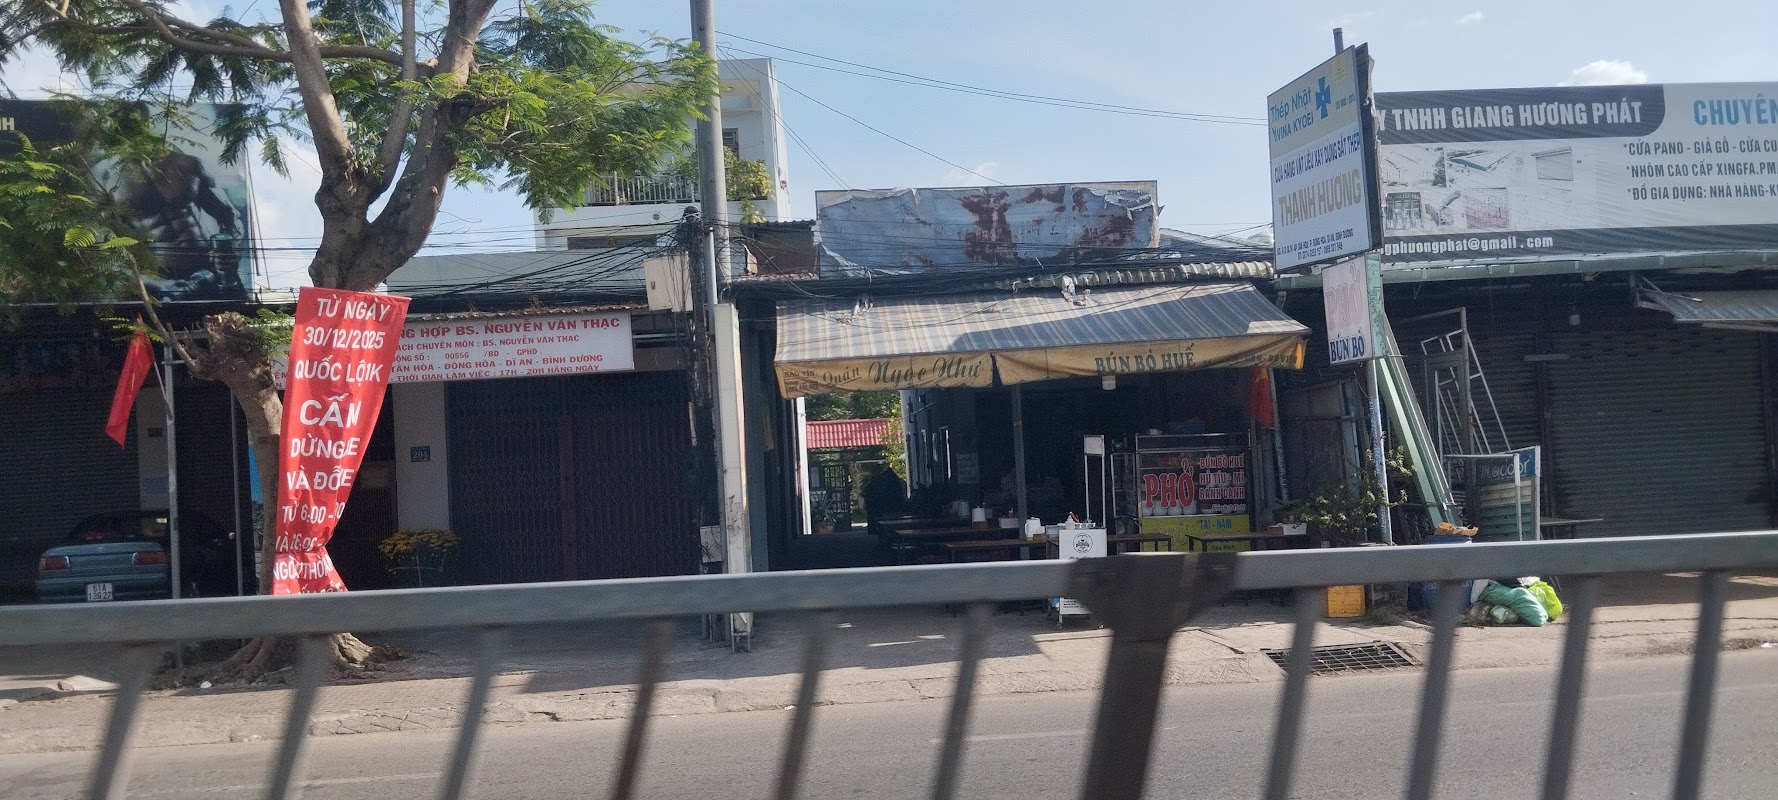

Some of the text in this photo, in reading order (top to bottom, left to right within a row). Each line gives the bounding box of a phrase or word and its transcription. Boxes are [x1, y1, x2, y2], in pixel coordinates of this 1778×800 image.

[1391, 107, 1447, 131] TNHH
[1451, 104, 1515, 129] GIANG
[1518, 102, 1588, 127] HƯƠNG
[1592, 97, 1643, 126] PHÁT
[1654, 141, 1684, 155] PANO
[1694, 137, 1713, 154] GIẢ
[1715, 136, 1730, 153] GỖ
[1667, 163, 1689, 177] CAO
[1691, 158, 1713, 176] CẤP
[1716, 161, 1778, 176] XINGFA.PM
[1278, 168, 1361, 227] THANH HƯƠNG
[1650, 186, 1670, 200] GIA
[1709, 183, 1733, 199] NHÀ
[1735, 182, 1778, 198] HÀNG-K
[317, 294, 391, 321] TỪ NGÀY
[303, 326, 386, 349] 30/12/2025
[420, 325, 451, 339] HỢP
[455, 325, 479, 336] BS.
[484, 318, 543, 335] NGUYỄN
[547, 319, 577, 331] VĂN
[581, 317, 620, 330] THẠC
[416, 341, 453, 351] CHUYÊN
[454, 340, 475, 348] MÔN
[482, 339, 497, 347] BS.
[499, 335, 534, 346] NGUYỄN
[537, 335, 554, 344] VĂN
[556, 334, 580, 344] THẠC
[1329, 326, 1365, 362] BÚN BÒ
[413, 362, 435, 372] HÒA
[444, 361, 472, 370] ĐÔNG
[475, 359, 496, 368] HÒA
[519, 358, 533, 366] AN
[542, 356, 566, 365] BÌNH
[569, 354, 604, 363] DƯƠNG
[414, 351, 425, 361] SỐ
[1094, 351, 1131, 374] BÚN
[1134, 349, 1158, 372] BÒ
[1160, 342, 1196, 369] HUẾ
[294, 355, 343, 381] QUỐC
[421, 373, 443, 381] GIAN
[446, 371, 467, 379] LÀM
[469, 369, 491, 379] VIỆC
[500, 368, 518, 377] 17H
[526, 367, 545, 375] 20H
[547, 365, 573, 373] HÀNG
[575, 364, 600, 372] NGÀY
[286, 465, 311, 490] VÀ
[1143, 457, 1195, 509] PHỞ
[281, 500, 300, 523] TỪ
[301, 503, 327, 524] 6:00
